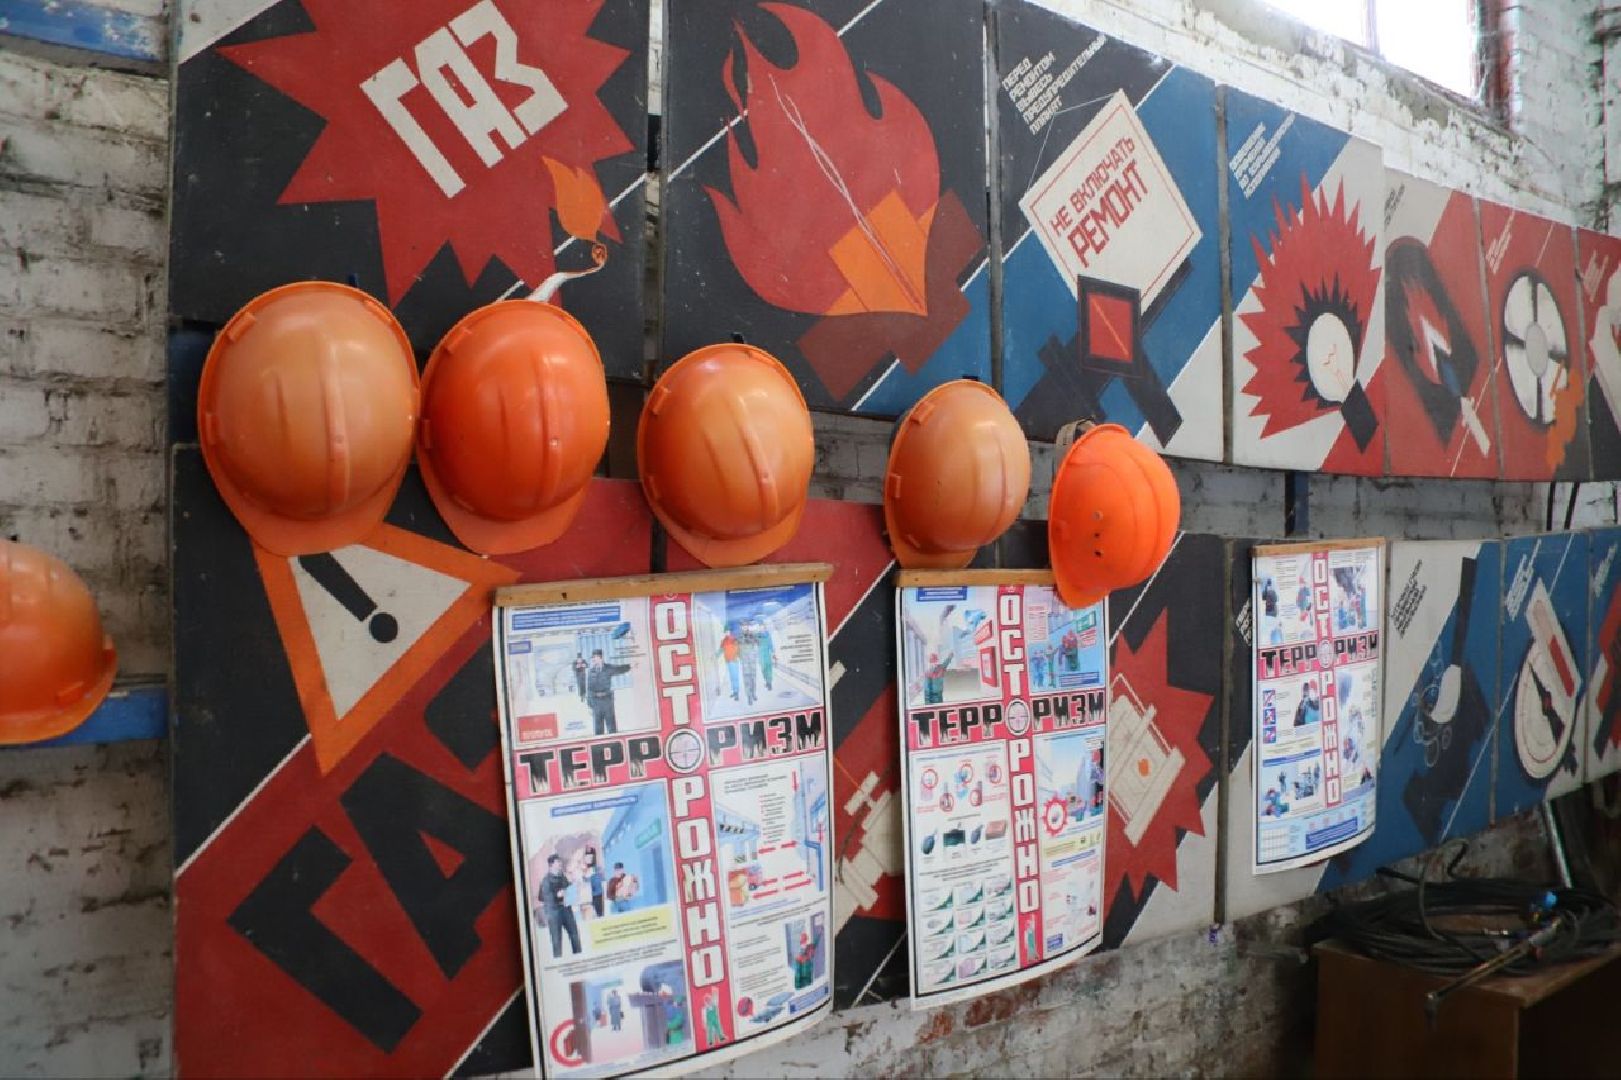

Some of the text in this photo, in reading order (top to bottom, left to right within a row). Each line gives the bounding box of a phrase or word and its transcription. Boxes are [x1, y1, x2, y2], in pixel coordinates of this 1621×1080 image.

[359, 0, 569, 199] ГАЗ
[1002, 57, 1032, 91] ПЕРЕД
[1049, 138, 1136, 236] НЕ ВКЛЮЧАТЬ
[1067, 159, 1149, 268] РЕМОНТ
[519, 710, 823, 793] ТЕРРОРИЗМ
[911, 690, 1105, 747] ТЕРРОРИЗМ
[1000, 595, 1040, 914] ОСТОРОЖНО
[654, 601, 724, 987] ОСТОРОЖНО
